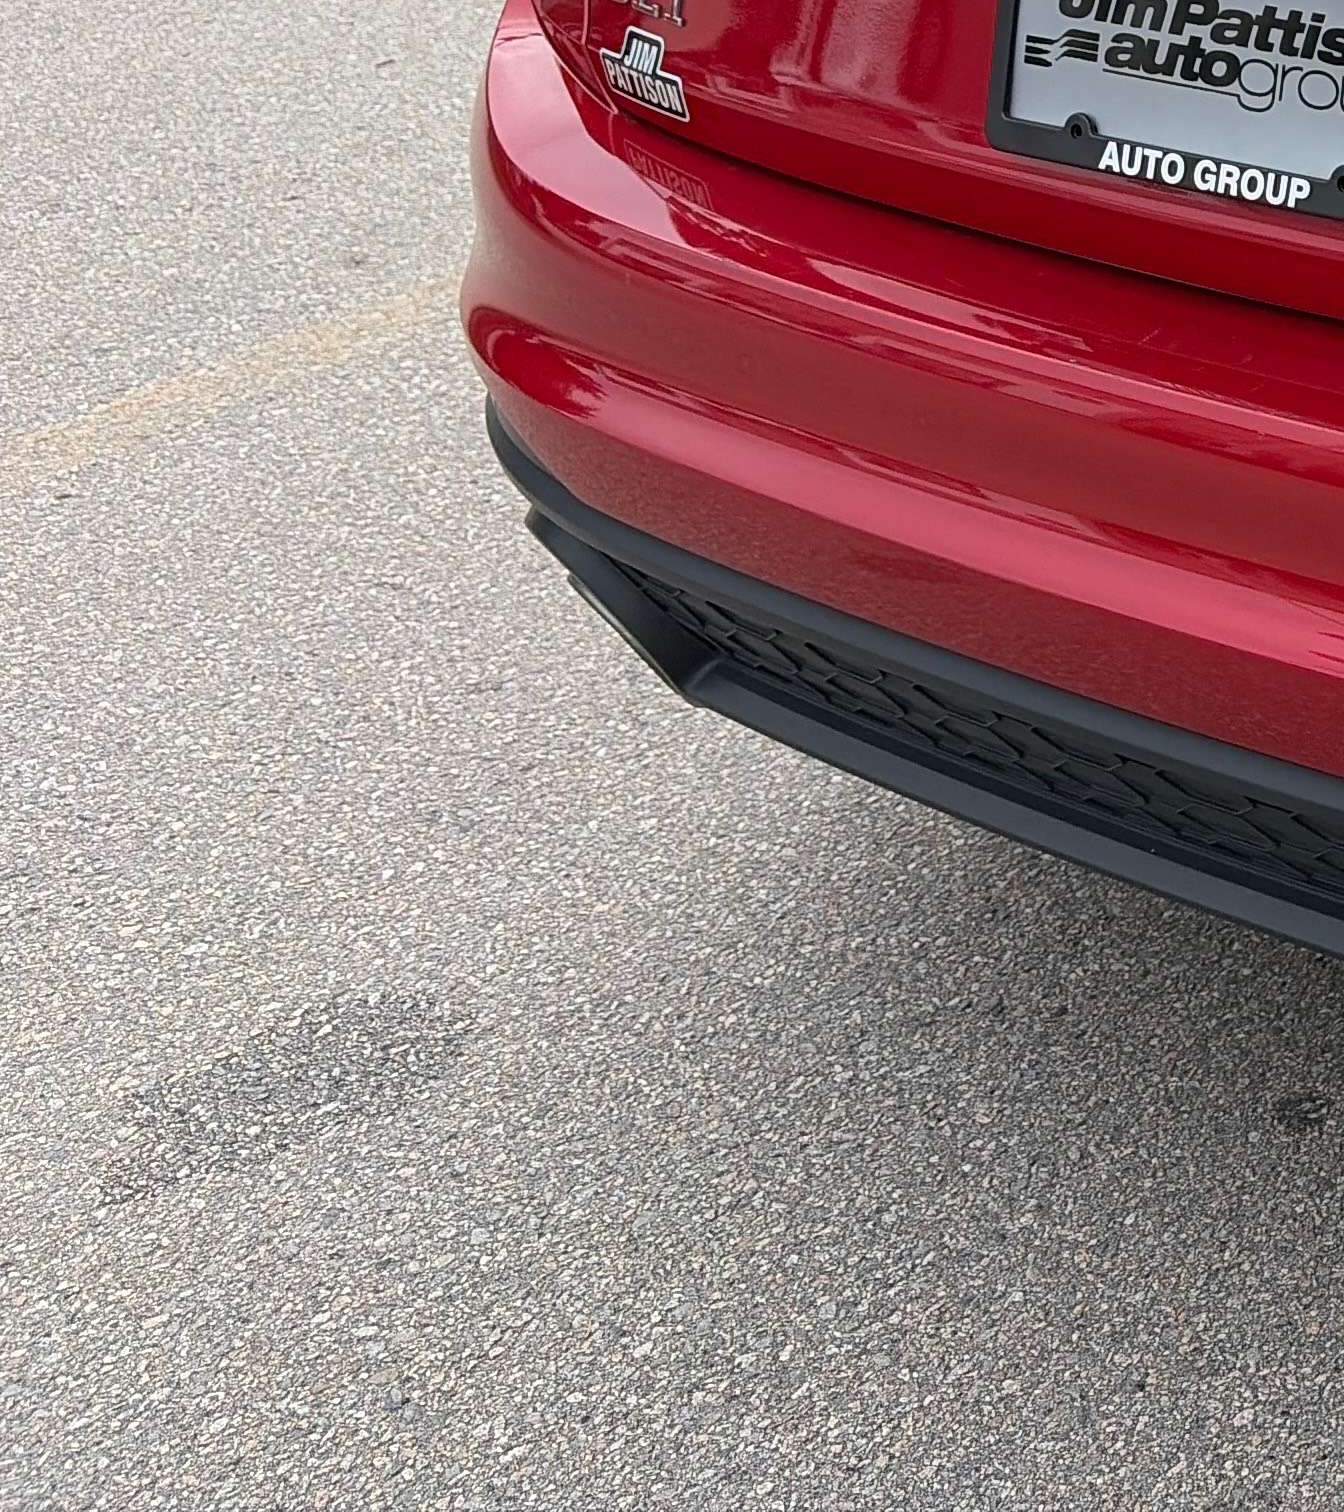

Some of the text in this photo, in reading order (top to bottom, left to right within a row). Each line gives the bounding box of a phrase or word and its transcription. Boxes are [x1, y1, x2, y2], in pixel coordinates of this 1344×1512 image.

[623, 37, 659, 75] JIM
[605, 57, 683, 114] PATTISON
[1098, 141, 1311, 209] AUTO GROUP
